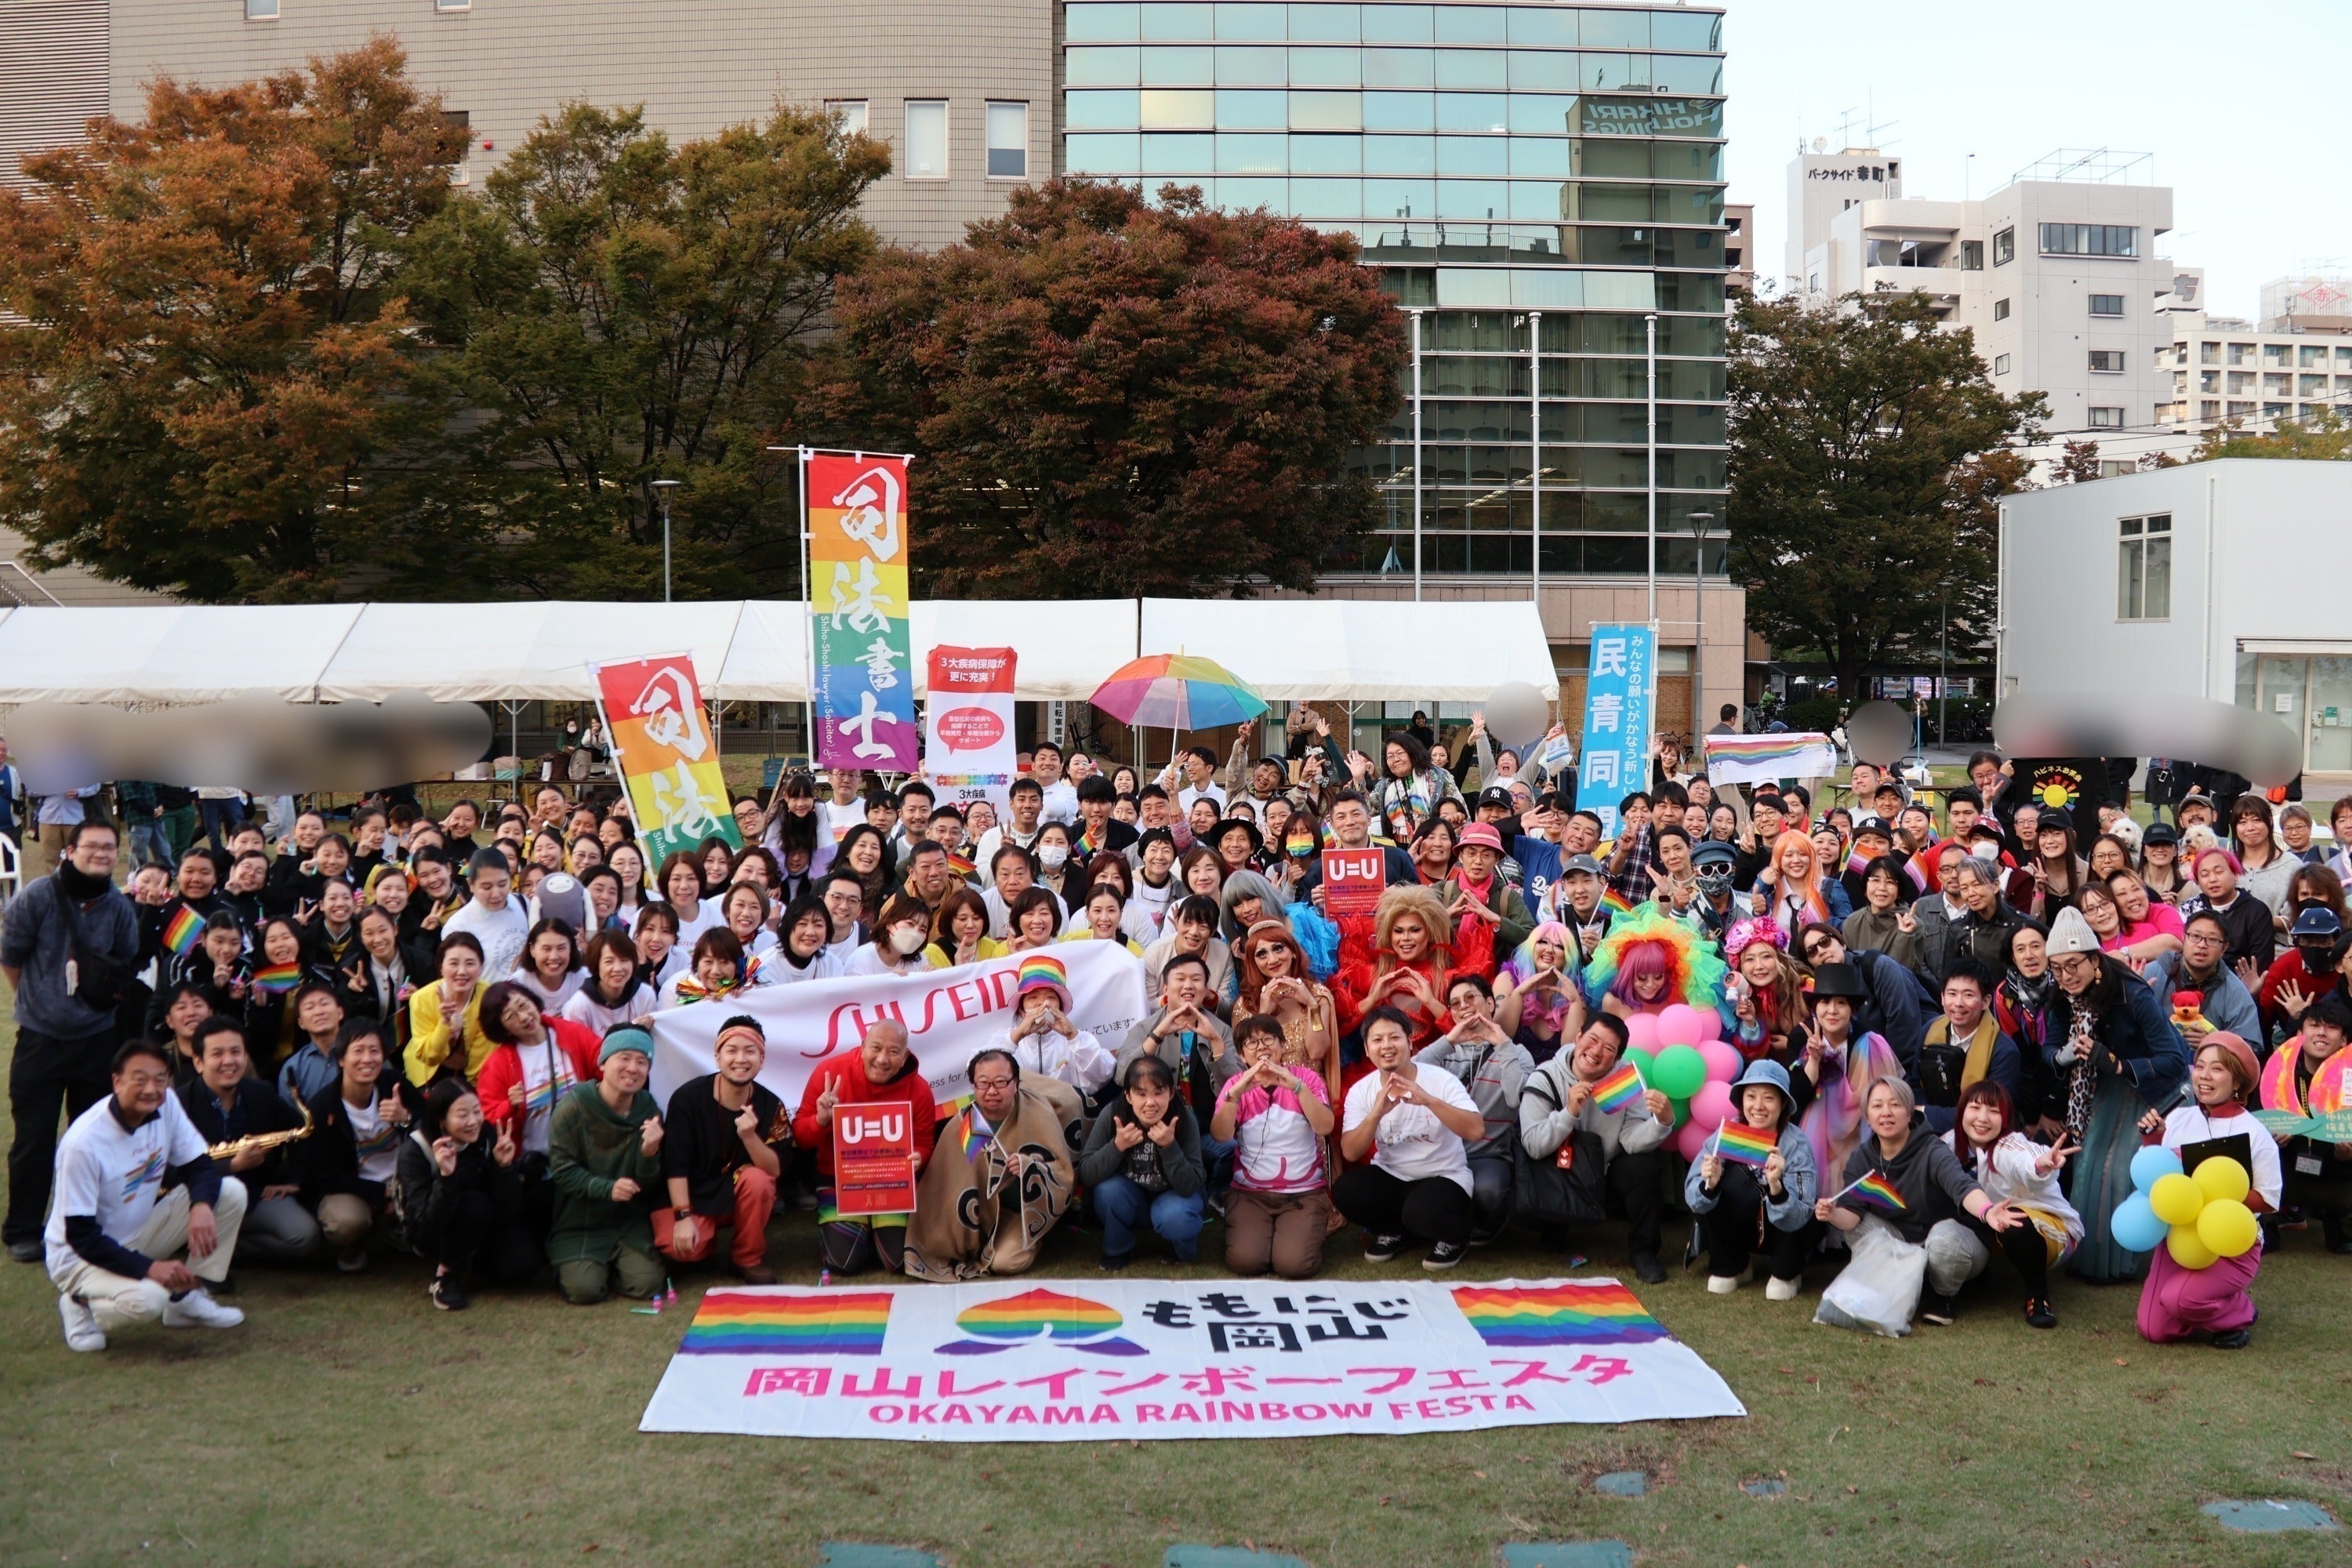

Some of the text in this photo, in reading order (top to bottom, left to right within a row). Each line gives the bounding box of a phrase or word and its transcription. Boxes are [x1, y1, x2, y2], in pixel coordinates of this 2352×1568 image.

[831, 466, 905, 761] 司法書士
[1623, 636, 1644, 797] みんなの願いがかなう新しい
[653, 832, 666, 861] Shiho-
[1328, 858, 1377, 881] U=U
[800, 970, 1019, 1058] SHISEID
[949, 1073, 961, 1083] for
[841, 1115, 903, 1144] U=U
[1142, 1293, 1410, 1329] ももにじ
[1207, 1316, 1388, 1353] 岡山
[743, 1355, 1634, 1399] 岡山レインボーフェスタ
[868, 1394, 1537, 1425] OKAYAMA RAINBOW FESTA
